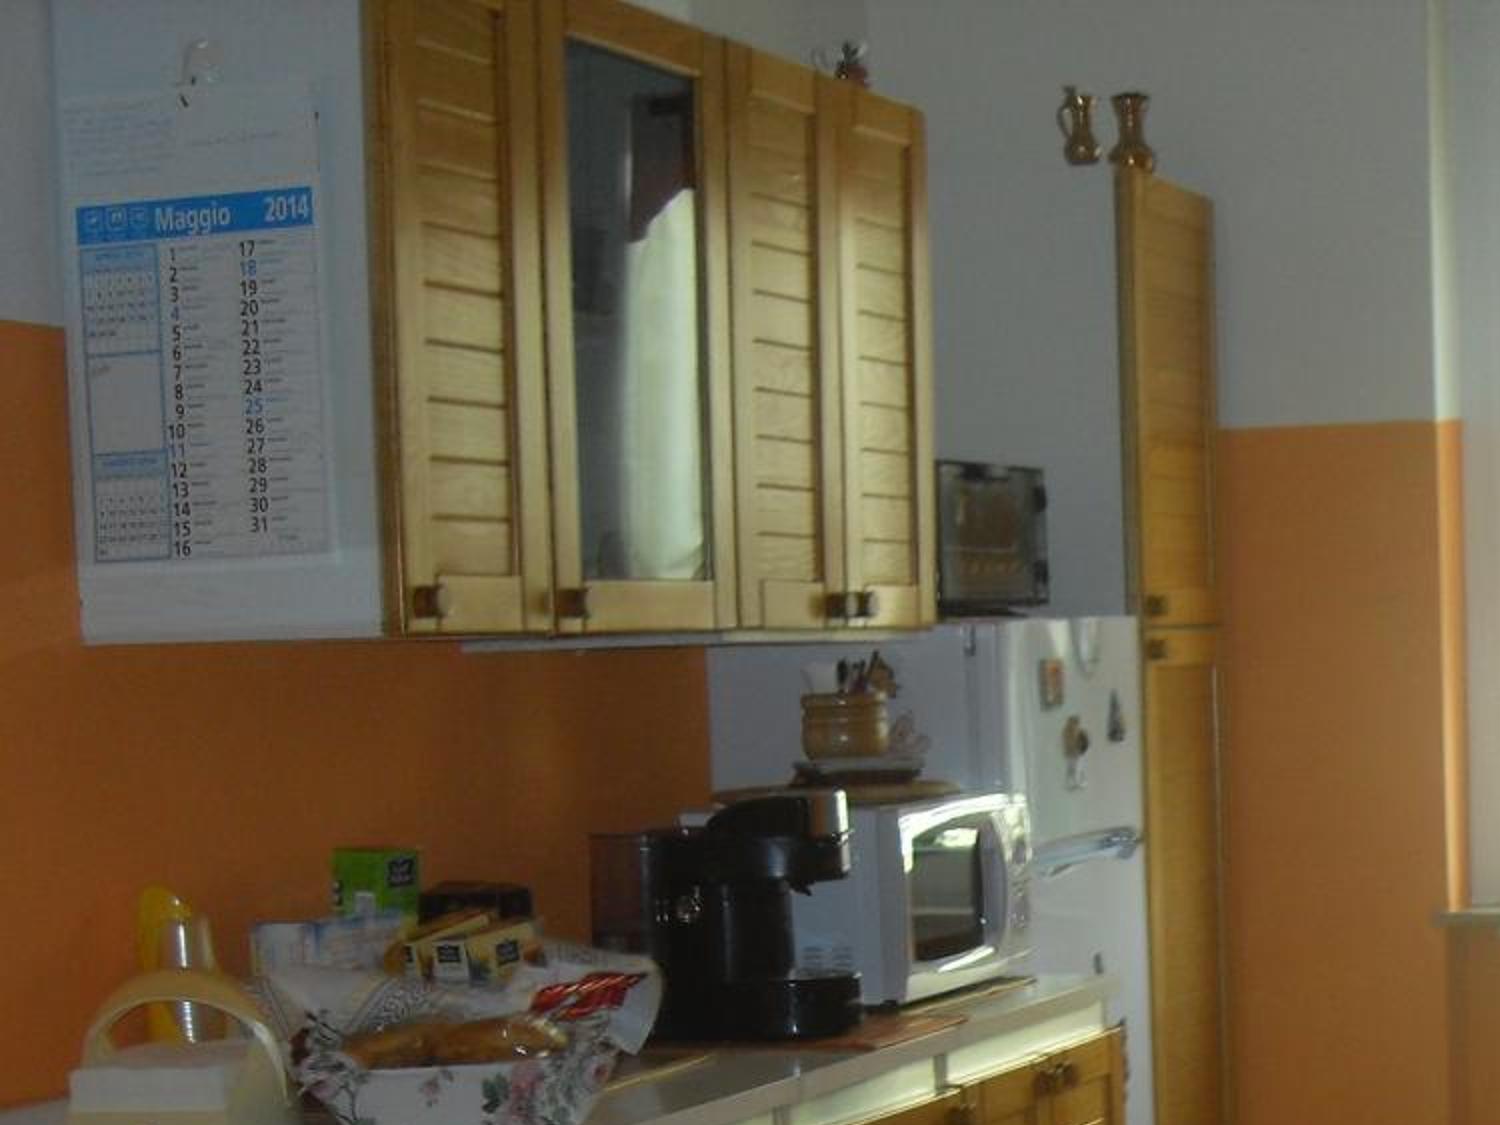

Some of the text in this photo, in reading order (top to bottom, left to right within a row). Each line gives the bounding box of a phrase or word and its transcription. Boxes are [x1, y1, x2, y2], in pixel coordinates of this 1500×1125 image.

[155, 195, 309, 233] Maggio 2014
[169, 248, 175, 261] 1
[239, 240, 255, 256] 17
[169, 267, 177, 282] 2
[240, 260, 256, 276] 18
[170, 286, 178, 302] 3
[240, 280, 257, 296] 19
[171, 307, 179, 321] 4
[240, 300, 259, 316] 20
[172, 325, 181, 342] 5
[241, 320, 259, 335] 21
[172, 345, 181, 361] 6
[242, 339, 260, 355] 22
[173, 365, 181, 380] 7
[243, 359, 261, 375] 23
[174, 384, 183, 400] 8
[244, 379, 262, 395] 24
[175, 404, 184, 419] 9
[245, 399, 263, 415] 25
[168, 424, 185, 439] 10
[246, 418, 264, 434] 26
[169, 444, 186, 458] 11
[247, 438, 265, 453] 27
[171, 463, 187, 478] 12
[248, 458, 267, 474] 28
[172, 483, 189, 498] 13
[249, 477, 267, 493] 29
[173, 501, 191, 517] 14
[250, 497, 268, 513] 30
[173, 521, 191, 537] 15
[251, 517, 268, 533] 31
[173, 541, 191, 557] 16
